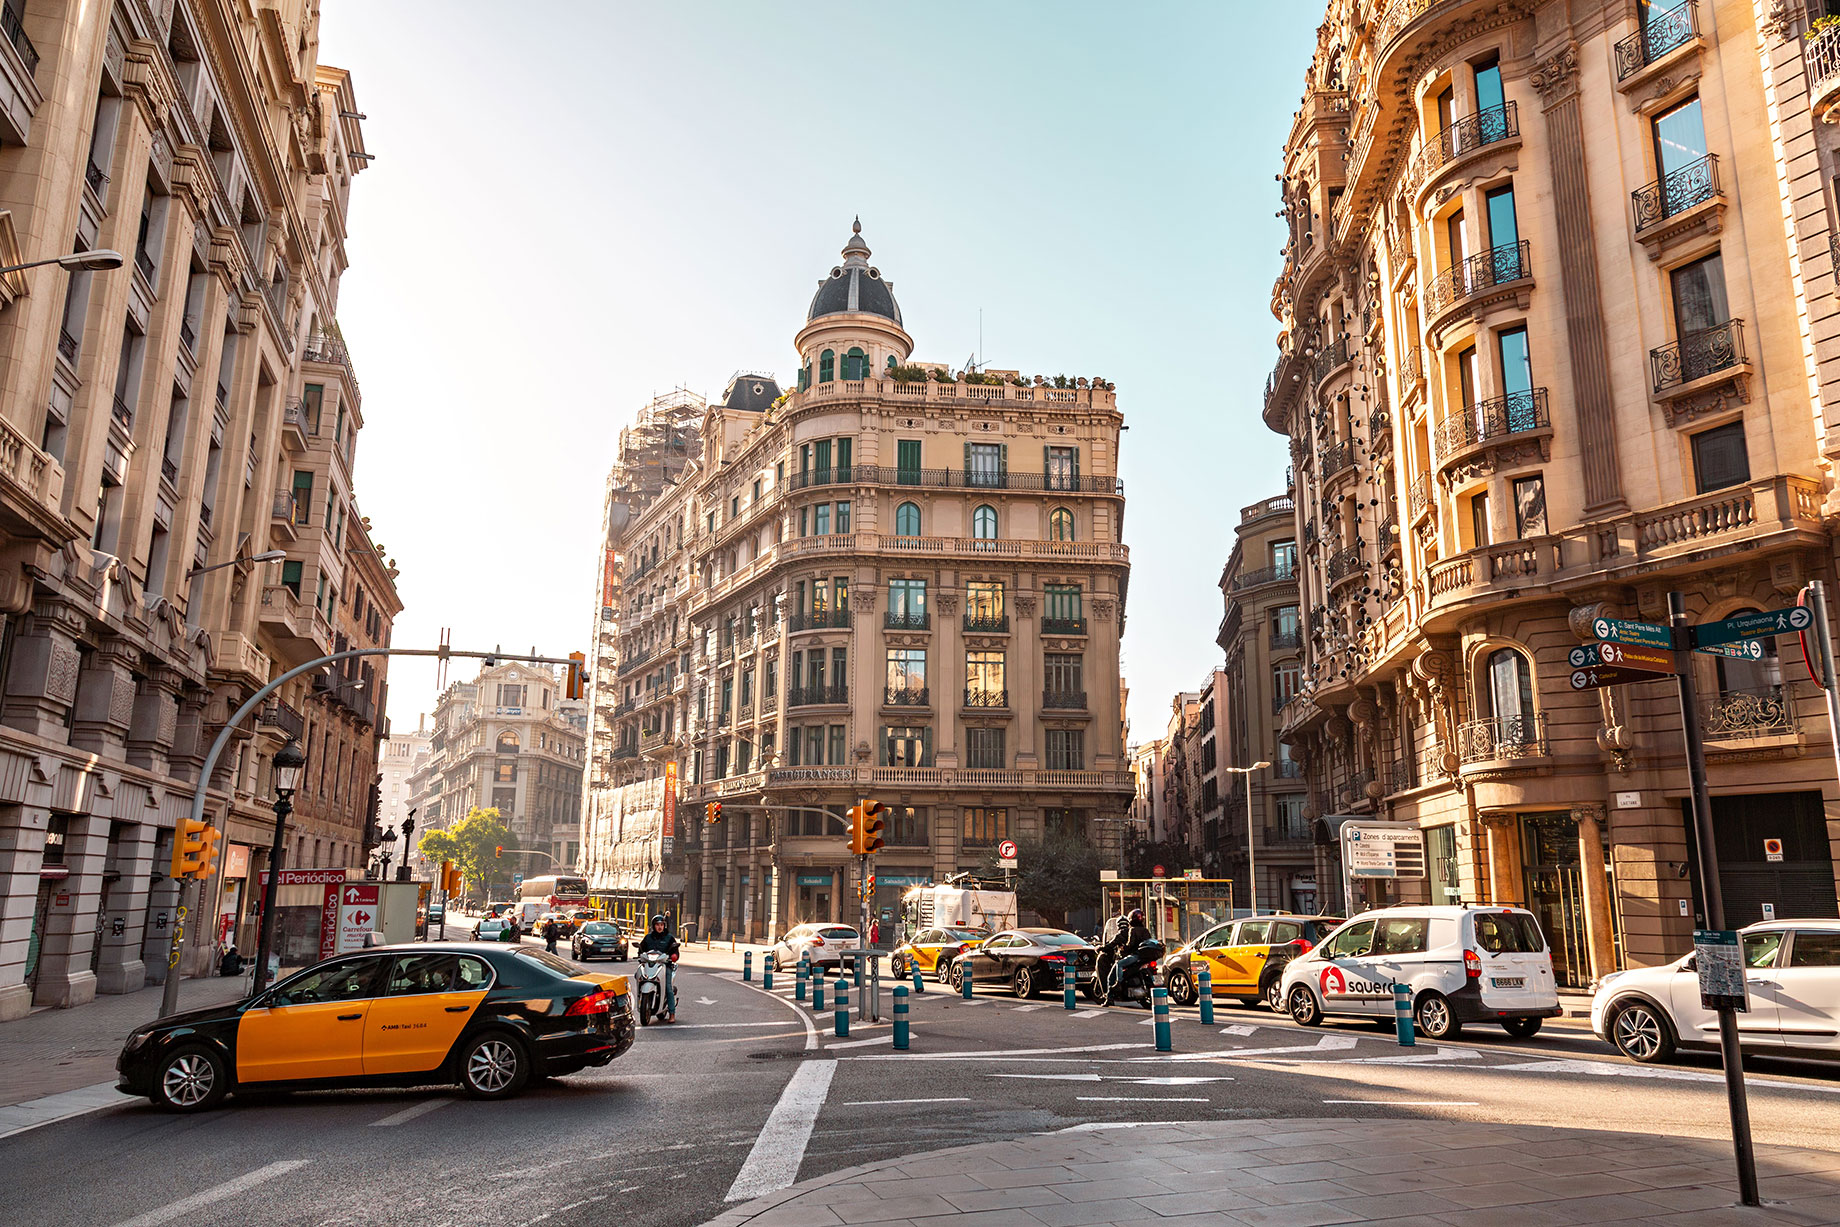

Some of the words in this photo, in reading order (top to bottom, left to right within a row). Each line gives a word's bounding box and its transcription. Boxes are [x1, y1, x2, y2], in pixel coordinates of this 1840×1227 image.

[1736, 616, 1774, 628] Urquinaona
[286, 872, 345, 884] Periódico
[322, 894, 338, 950] Periódico
